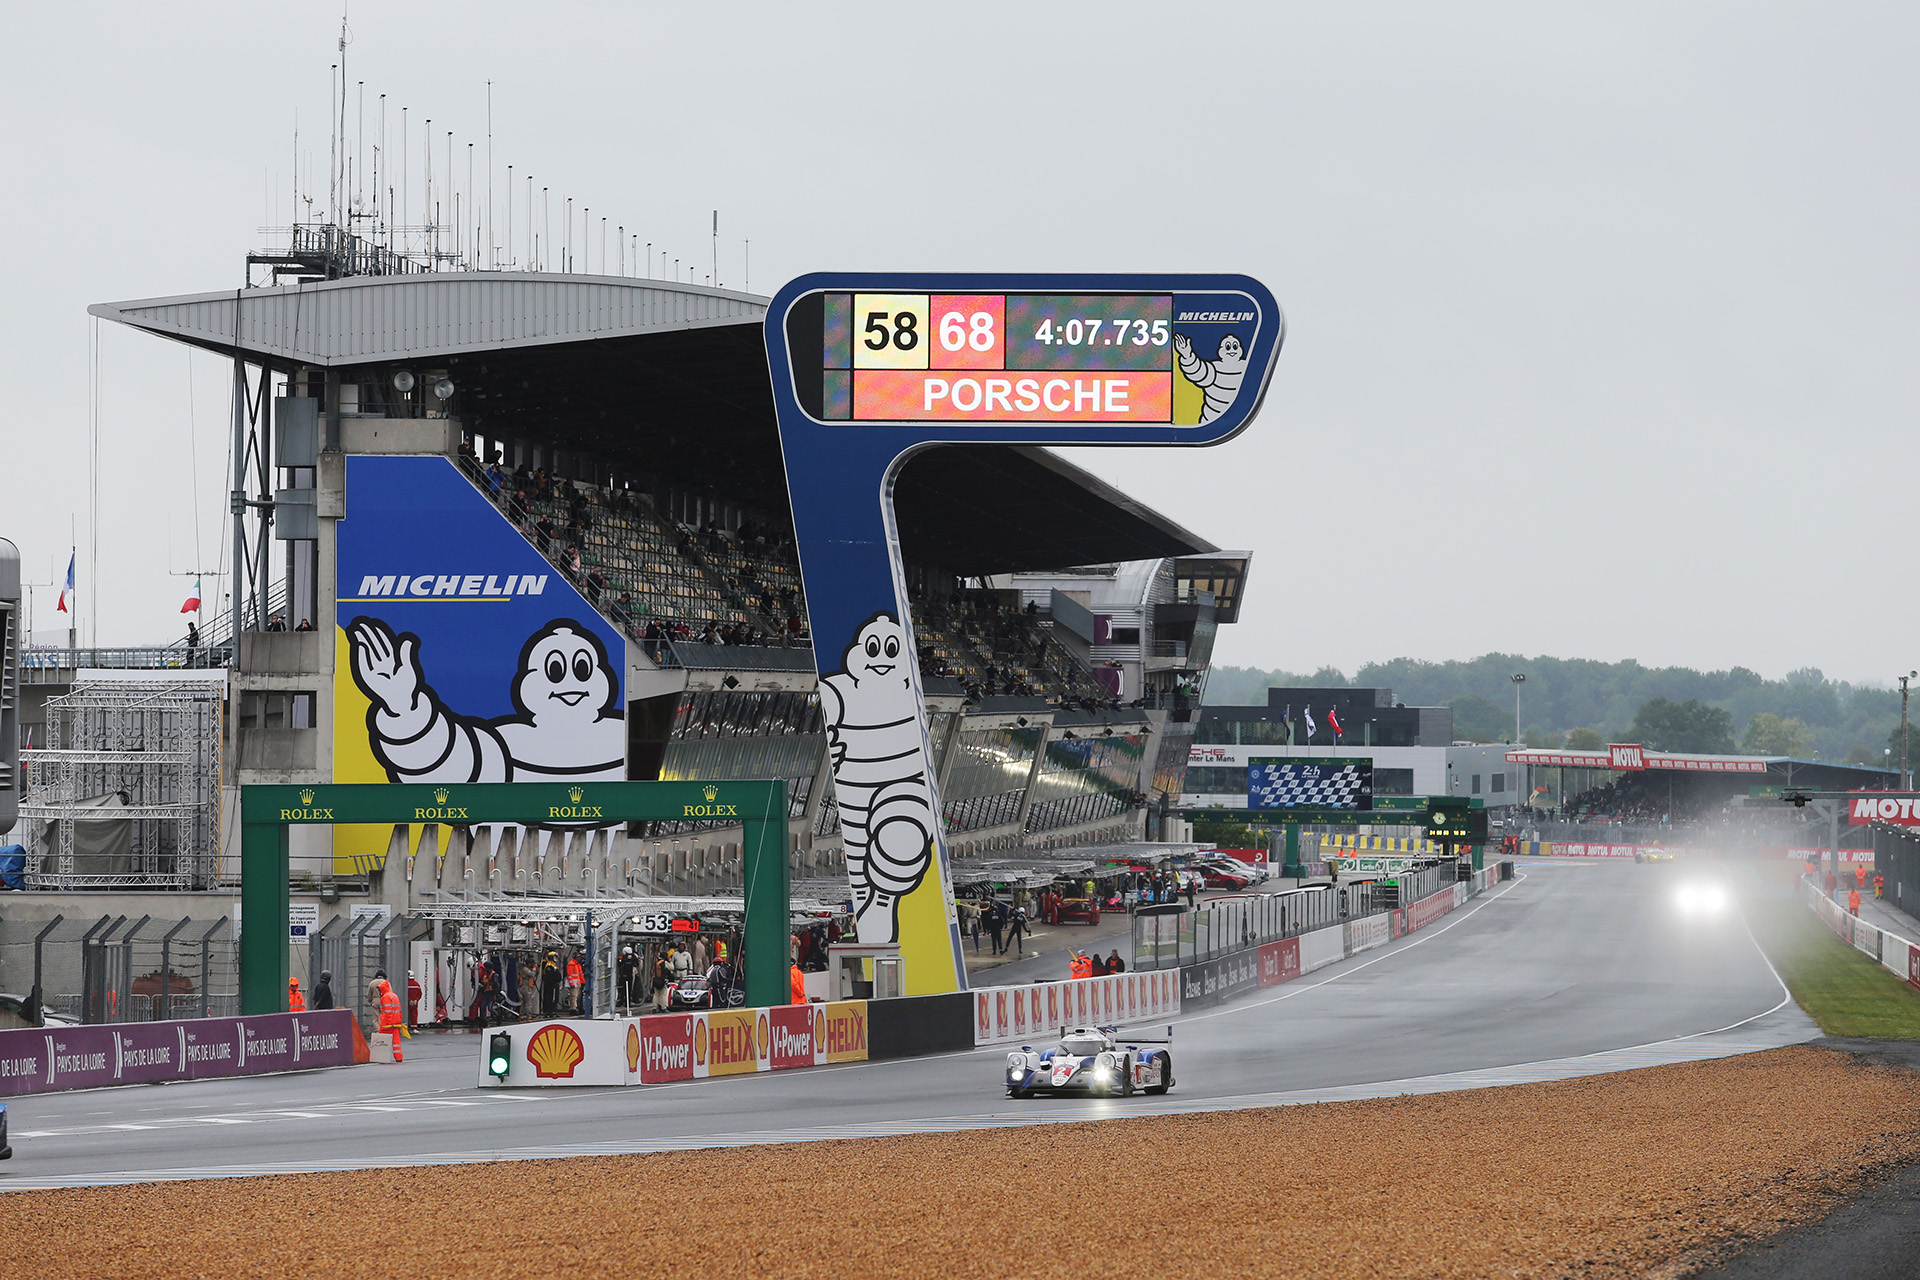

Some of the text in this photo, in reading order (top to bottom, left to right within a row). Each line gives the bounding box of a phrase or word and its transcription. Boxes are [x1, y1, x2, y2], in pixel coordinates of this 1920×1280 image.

[1177, 311, 1256, 323] MICHELIN
[863, 312, 919, 351] 58
[938, 311, 996, 352] 68
[1034, 318, 1170, 347] 4:07.735
[923, 378, 1131, 412] PORSCHE
[357, 574, 548, 596] MICHELIN
[1612, 747, 1643, 767] MOTUL
[280, 809, 334, 821] ROLEX
[414, 808, 468, 820] ROLEX
[549, 806, 602, 818] ROLEX
[684, 805, 737, 817] ROLEX
[1568, 845, 1586, 856] MOTUL
[1587, 846, 1608, 856] MOTUL
[1610, 846, 1634, 856] MOTUL
[645, 915, 668, 931] 53
[689, 921, 698, 930] 41
[772, 1025, 811, 1058] V-Power
[827, 1012, 866, 1052] HELIX
[247, 1038, 288, 1056] PAYS DE LA LOIRE
[302, 1034, 338, 1051] PAYS DE LA LOIRE
[709, 1020, 754, 1064] HELIX
[124, 1047, 170, 1068] PAYS DE LA LOIRE
[188, 1043, 230, 1062] PAYS DE LA LOIRE
[643, 1036, 690, 1071] V-Power
[2, 1057, 37, 1077] DE LA LOIRE
[57, 1053, 106, 1073] PAYS DE LA LOIRE
[1057, 1066, 1066, 1075] 2
